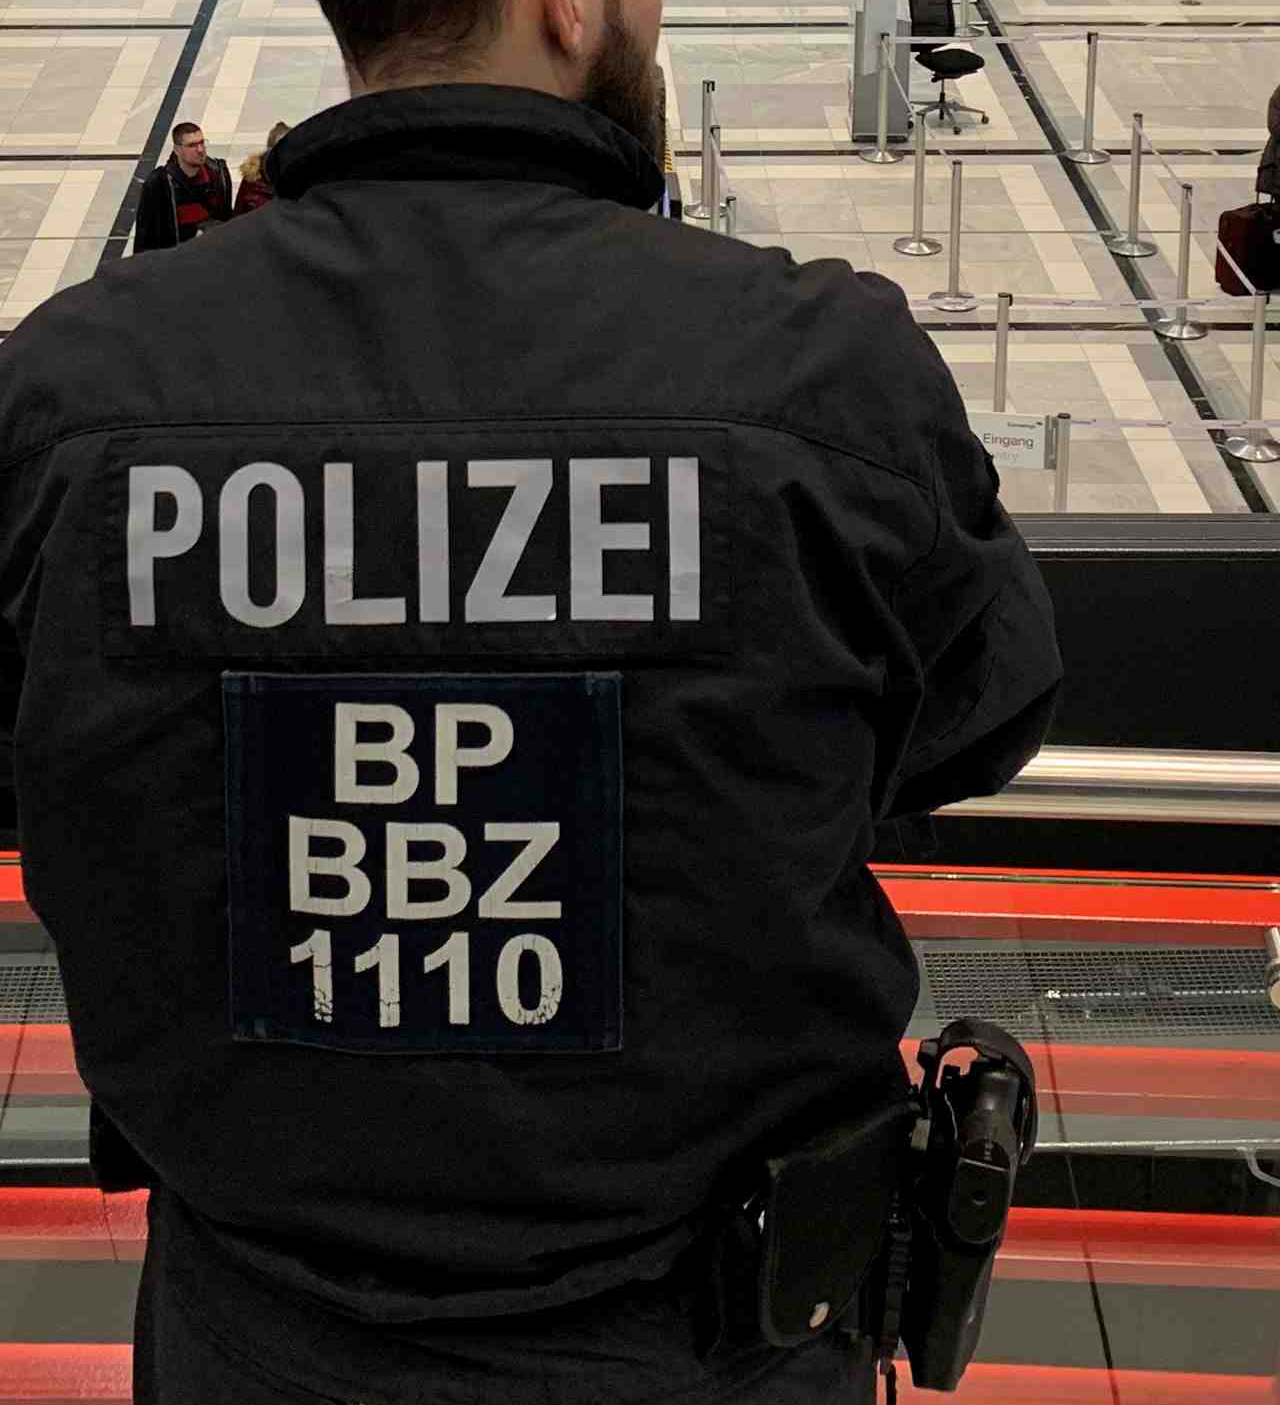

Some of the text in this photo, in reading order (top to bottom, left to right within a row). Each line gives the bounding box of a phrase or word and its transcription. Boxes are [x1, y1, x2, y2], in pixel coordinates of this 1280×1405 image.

[983, 433, 1035, 450] Eingang
[126, 456, 701, 628] POLIZEI
[333, 701, 515, 806] BP
[288, 814, 562, 920] BBZ
[288, 928, 564, 1028] 1110
